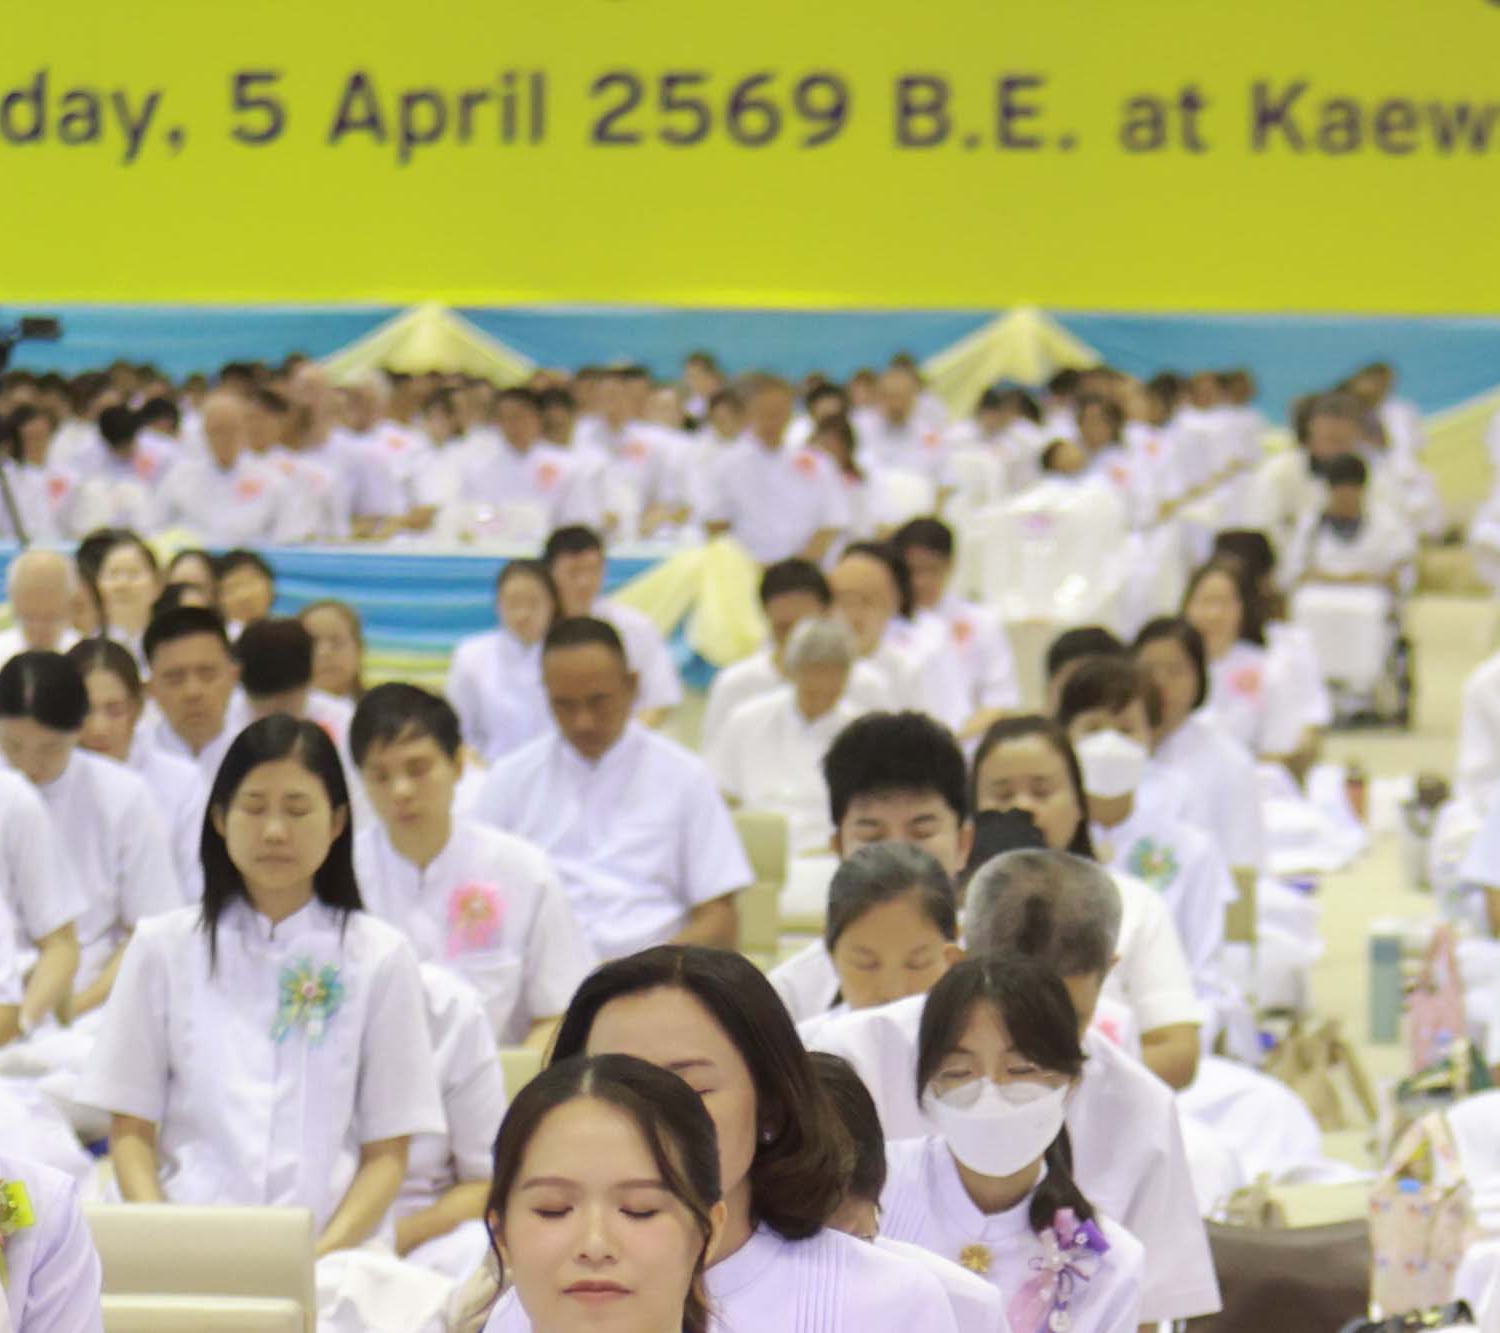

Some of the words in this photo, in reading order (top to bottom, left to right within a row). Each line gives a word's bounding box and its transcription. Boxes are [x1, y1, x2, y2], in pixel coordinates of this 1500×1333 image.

[230, 68, 288, 147] 5
[326, 69, 548, 166] April
[589, 68, 853, 149] 2569
[892, 72, 1078, 152] B.E.
[1118, 84, 1209, 155] at
